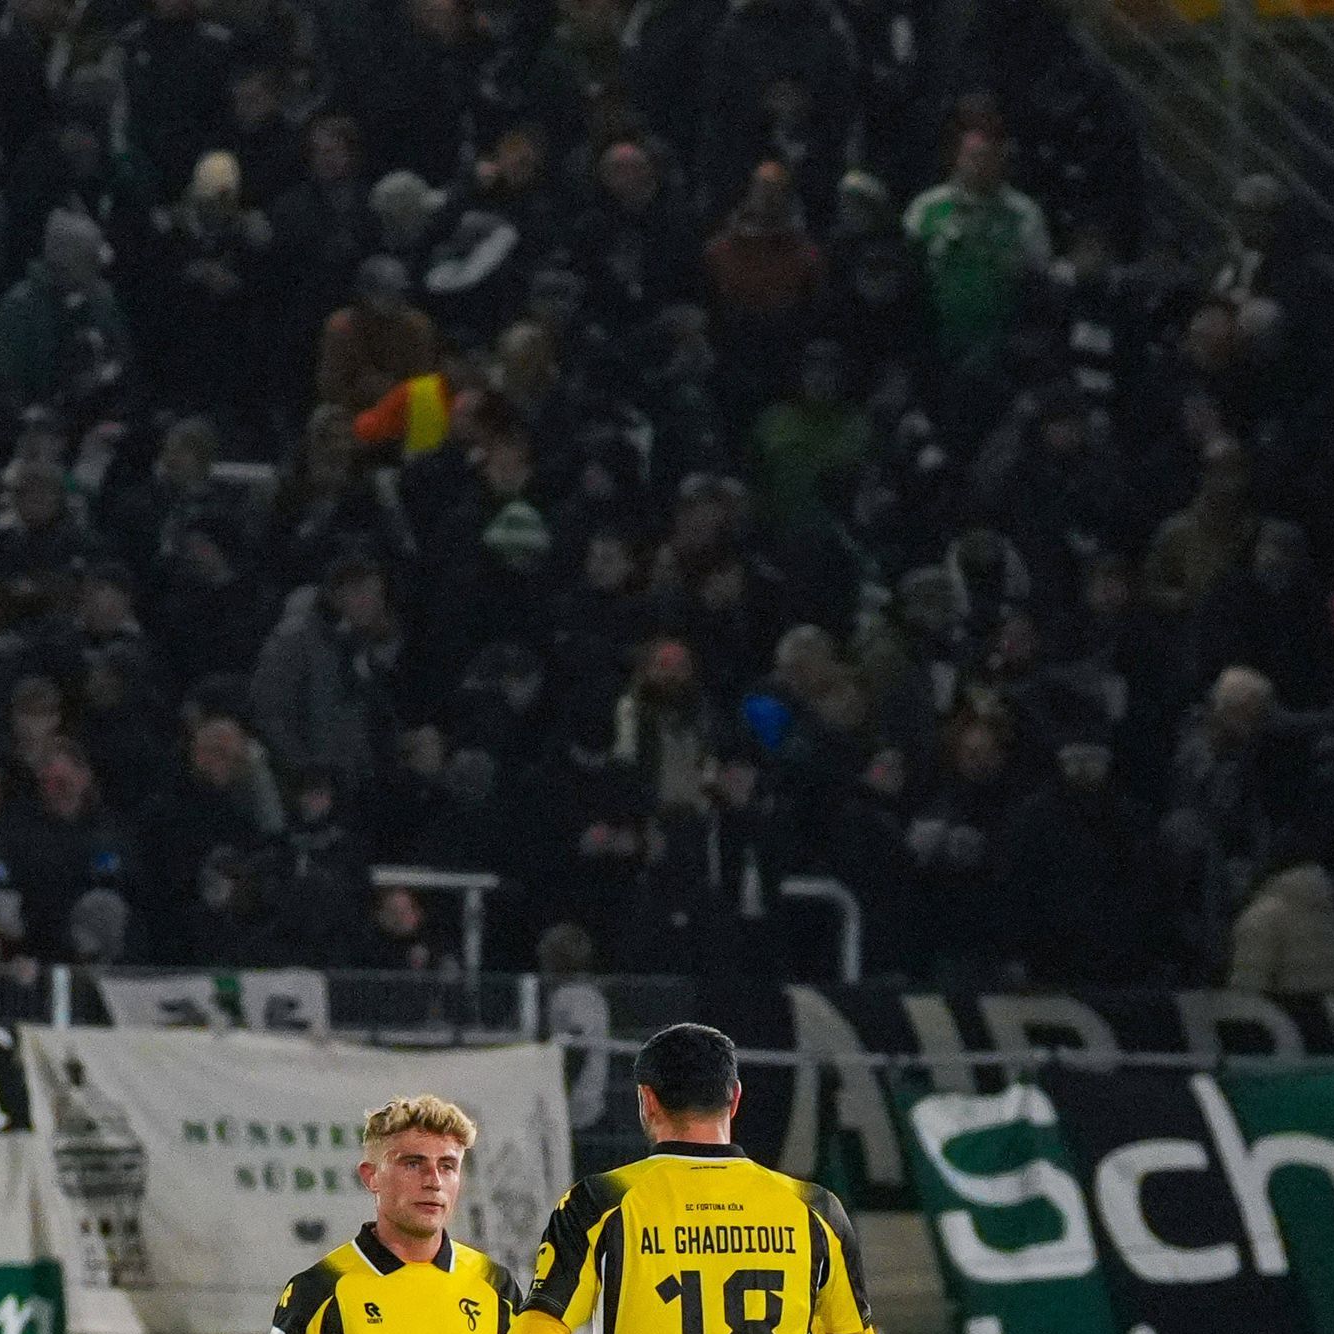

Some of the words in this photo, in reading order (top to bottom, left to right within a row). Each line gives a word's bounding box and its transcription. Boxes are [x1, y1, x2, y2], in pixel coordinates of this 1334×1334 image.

[696, 1203, 725, 1211] FORTUNA
[728, 1202, 744, 1211] KÖLN
[640, 1226, 666, 1254] AL
[674, 1225, 796, 1254] GHADDIOUI
